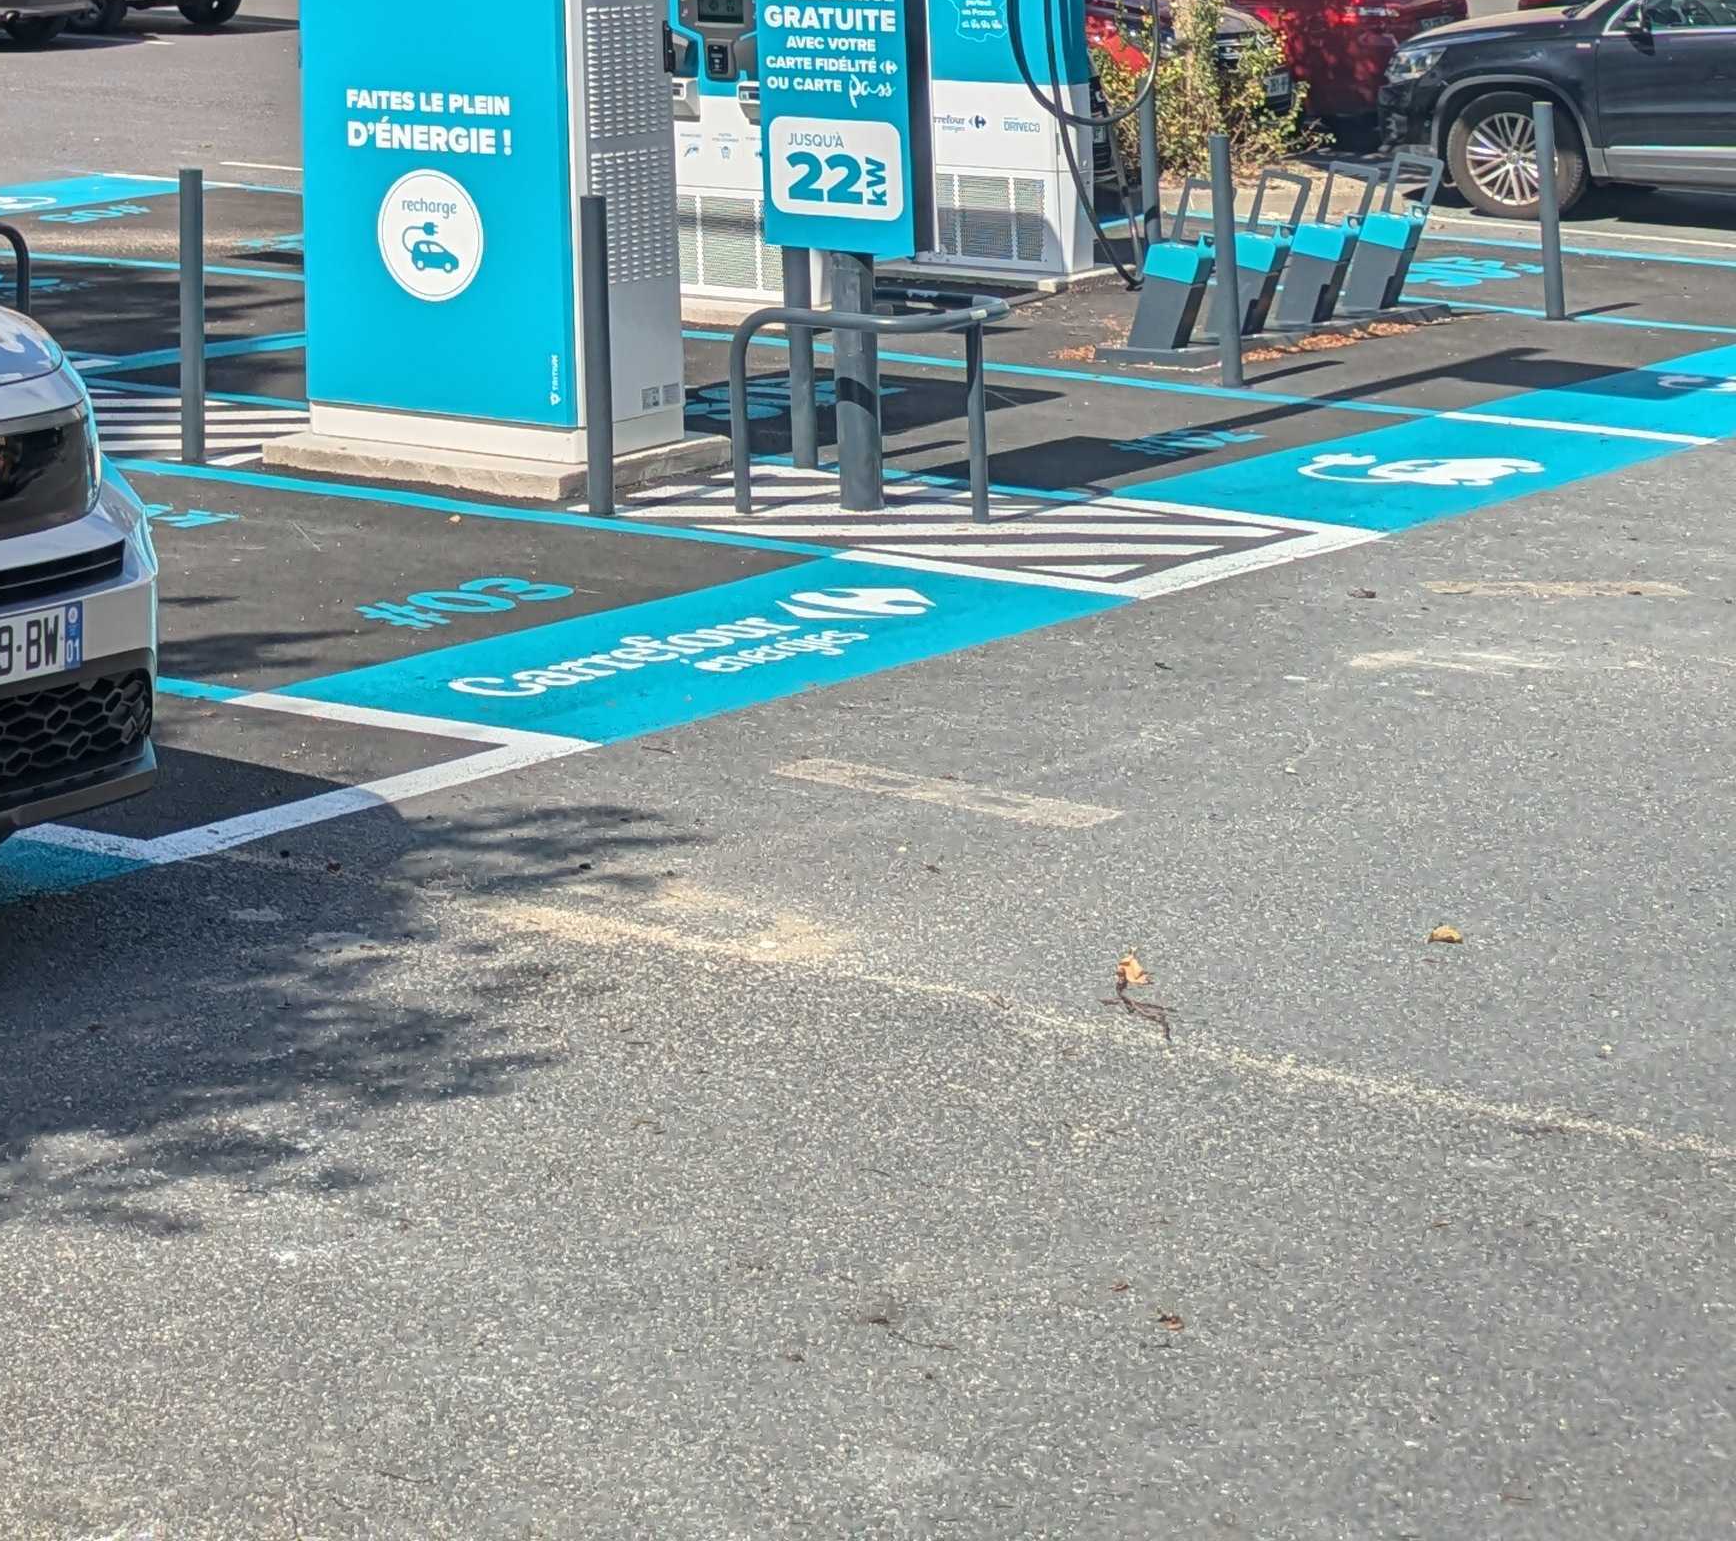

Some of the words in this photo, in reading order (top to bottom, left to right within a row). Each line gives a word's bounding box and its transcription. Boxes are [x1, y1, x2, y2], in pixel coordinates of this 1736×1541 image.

[765, 5, 896, 32] GRATUITE
[786, 36, 824, 49] AVEC
[827, 37, 876, 52] VOTRE
[766, 56, 812, 70] CARTE
[816, 56, 877, 73] FIDÉLITÉ
[767, 76, 789, 89] OU
[793, 78, 842, 92] CARTE
[346, 88, 415, 111] FAITES
[419, 92, 444, 112] LE
[449, 93, 511, 116] PLEIN
[347, 116, 496, 155] D'ÉNERGIE
[503, 129, 512, 156] !
[1004, 121, 1040, 133] DRIVECO
[788, 132, 844, 148] JUSQU'À
[786, 151, 863, 205] 22
[865, 156, 887, 206] kW
[402, 198, 457, 219] recharge
[354, 577, 574, 631] #03
[66, 638, 80, 663] 01
[448, 616, 801, 697] Carrefour
